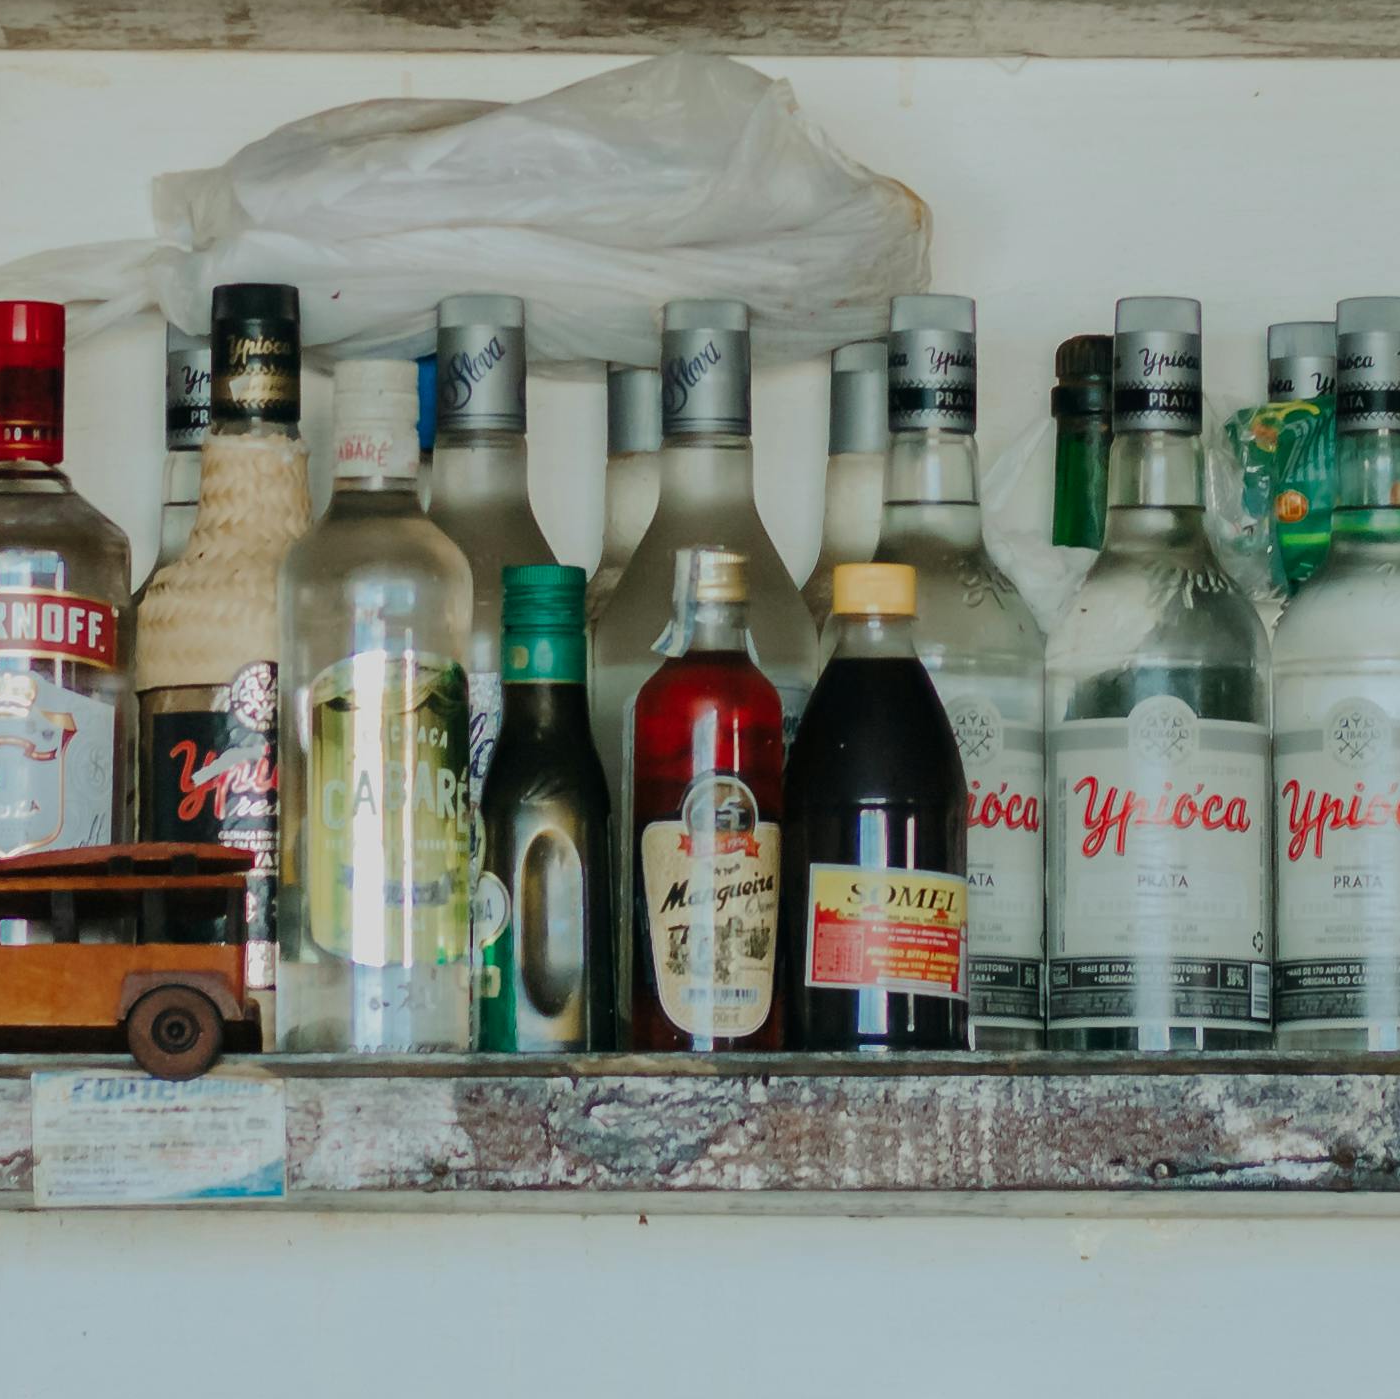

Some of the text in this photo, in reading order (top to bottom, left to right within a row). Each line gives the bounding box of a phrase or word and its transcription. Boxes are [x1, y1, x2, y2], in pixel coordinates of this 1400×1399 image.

[322, 756, 472, 837] CABARÉ
[1073, 775, 1251, 858] Ypióca
[1137, 874, 1189, 889] PRATA
[1333, 874, 1384, 889] PRATA
[847, 883, 960, 913] SOMEL
[1325, 965, 1348, 975] ANOS
[1302, 975, 1351, 987] ORIGINAL DO
